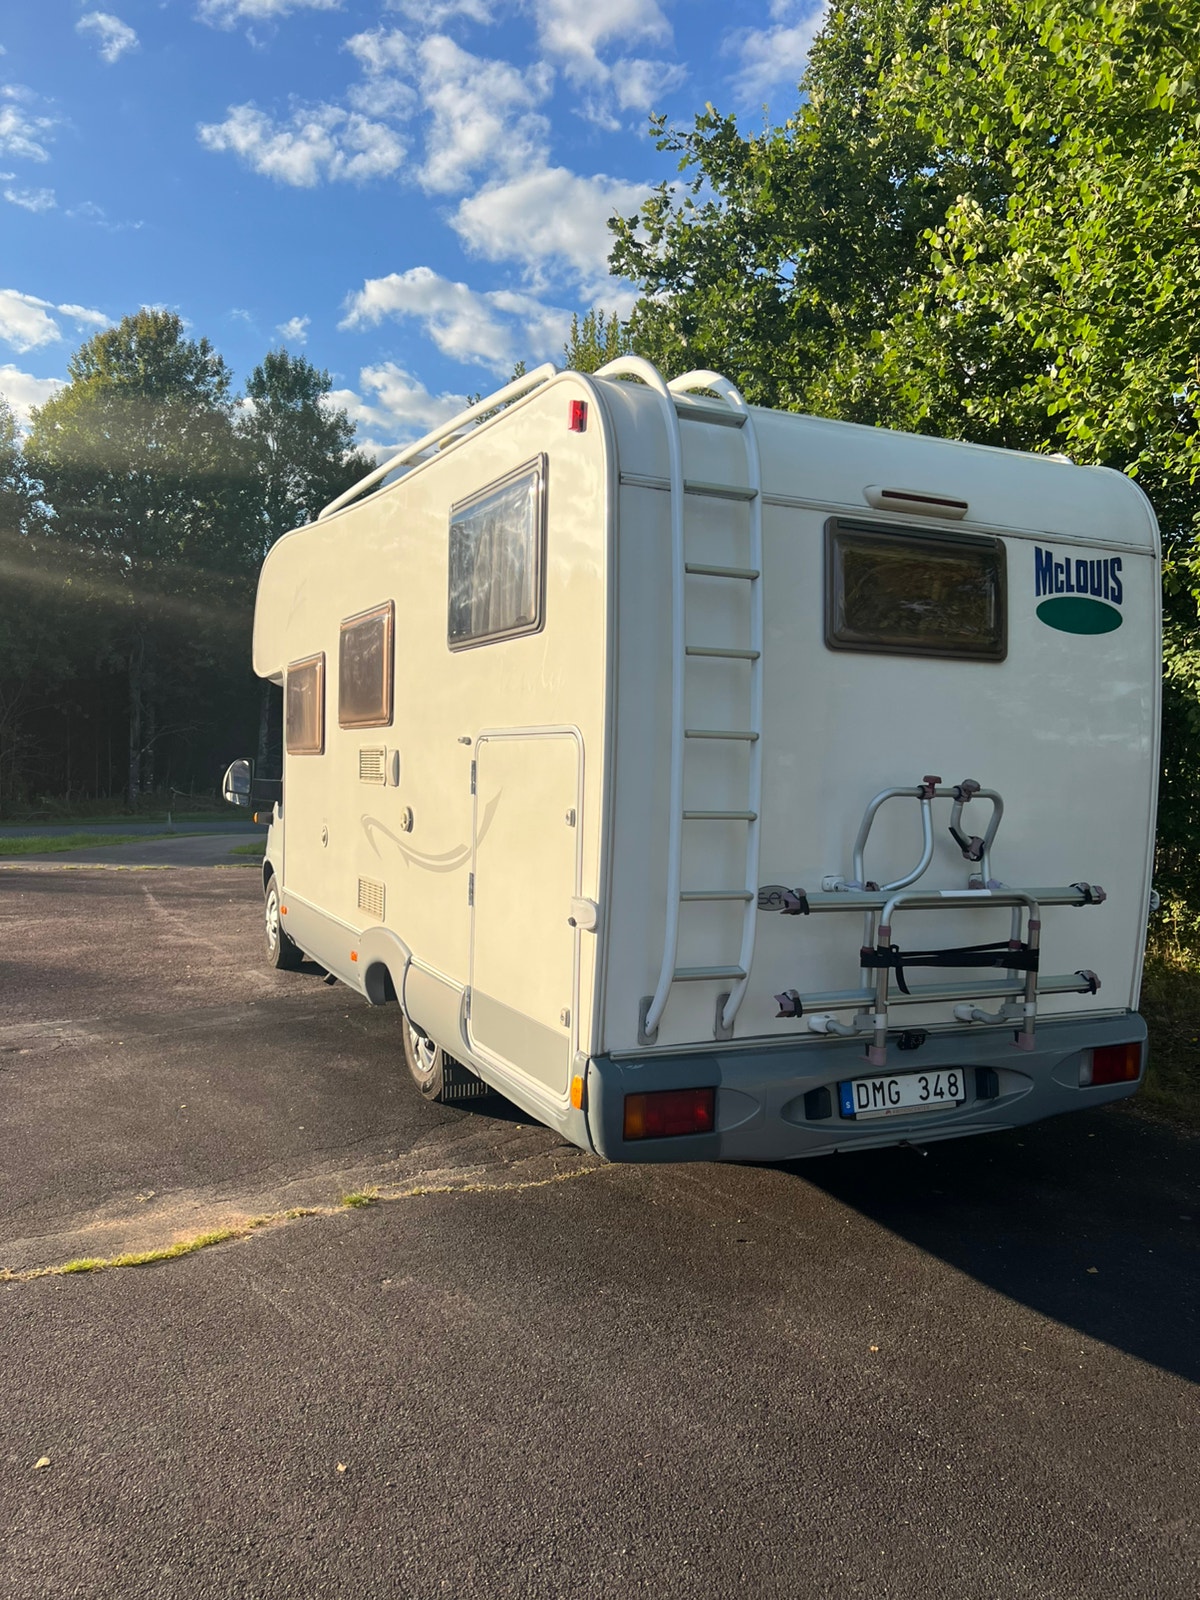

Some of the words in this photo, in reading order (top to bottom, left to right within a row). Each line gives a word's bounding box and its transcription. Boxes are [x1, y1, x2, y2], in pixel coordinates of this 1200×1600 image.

[856, 1080, 901, 1109] DMG
[918, 1074, 959, 1101] 348
[846, 1101, 851, 1109] S
